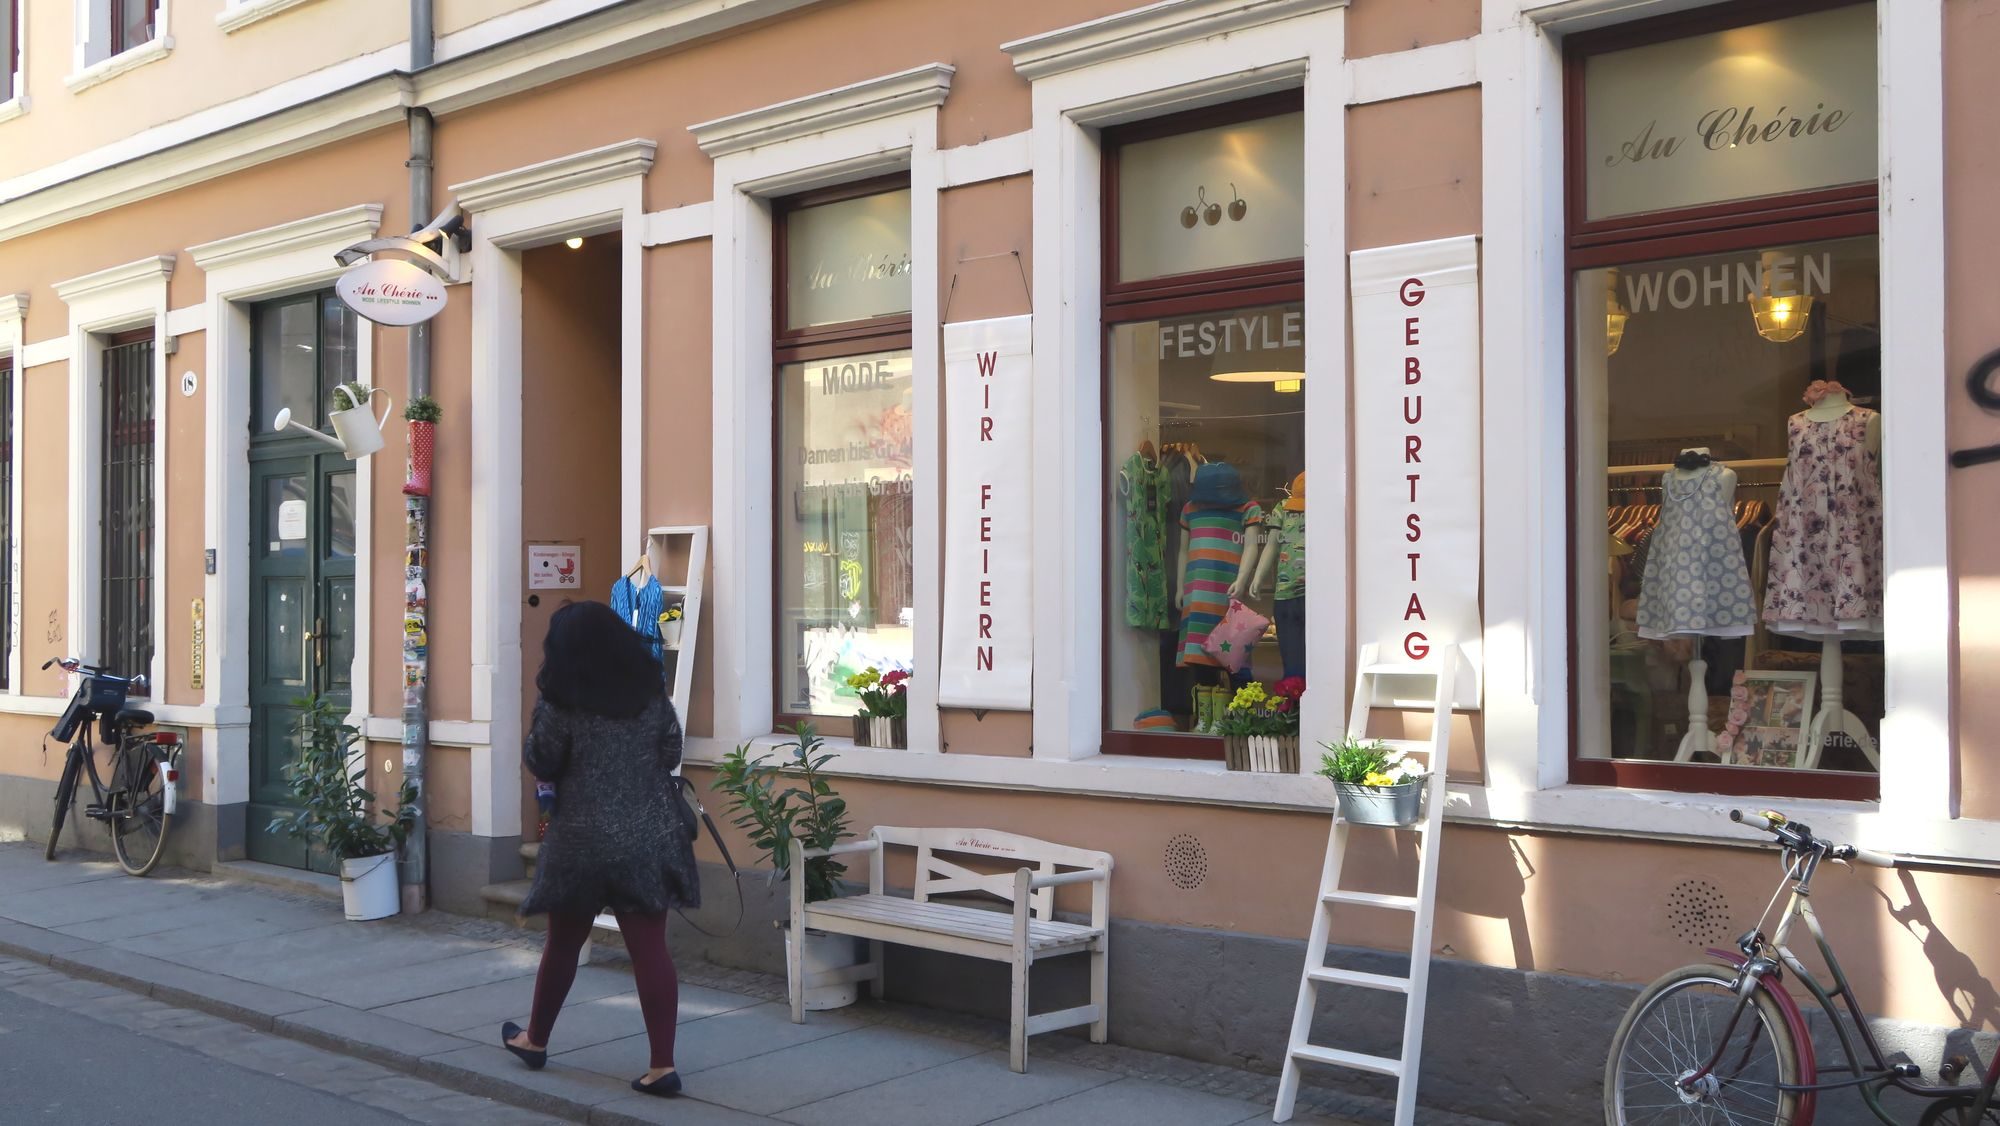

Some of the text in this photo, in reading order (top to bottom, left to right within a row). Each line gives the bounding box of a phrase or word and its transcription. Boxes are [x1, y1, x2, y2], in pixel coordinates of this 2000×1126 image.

[1605, 103, 1853, 168] Au Chérie
[352, 282, 423, 299] Au Chérie
[1625, 252, 1831, 314] WOHNEN
[1159, 312, 1301, 360] FESTYLE
[183, 375, 194, 392] 18
[822, 360, 891, 395] MODE
[976, 351, 998, 442] WIR
[798, 445, 846, 465] Damen
[1399, 277, 1430, 661] GEBURTSTAG
[869, 475, 890, 497] Gr.
[976, 484, 994, 672] FEIERN
